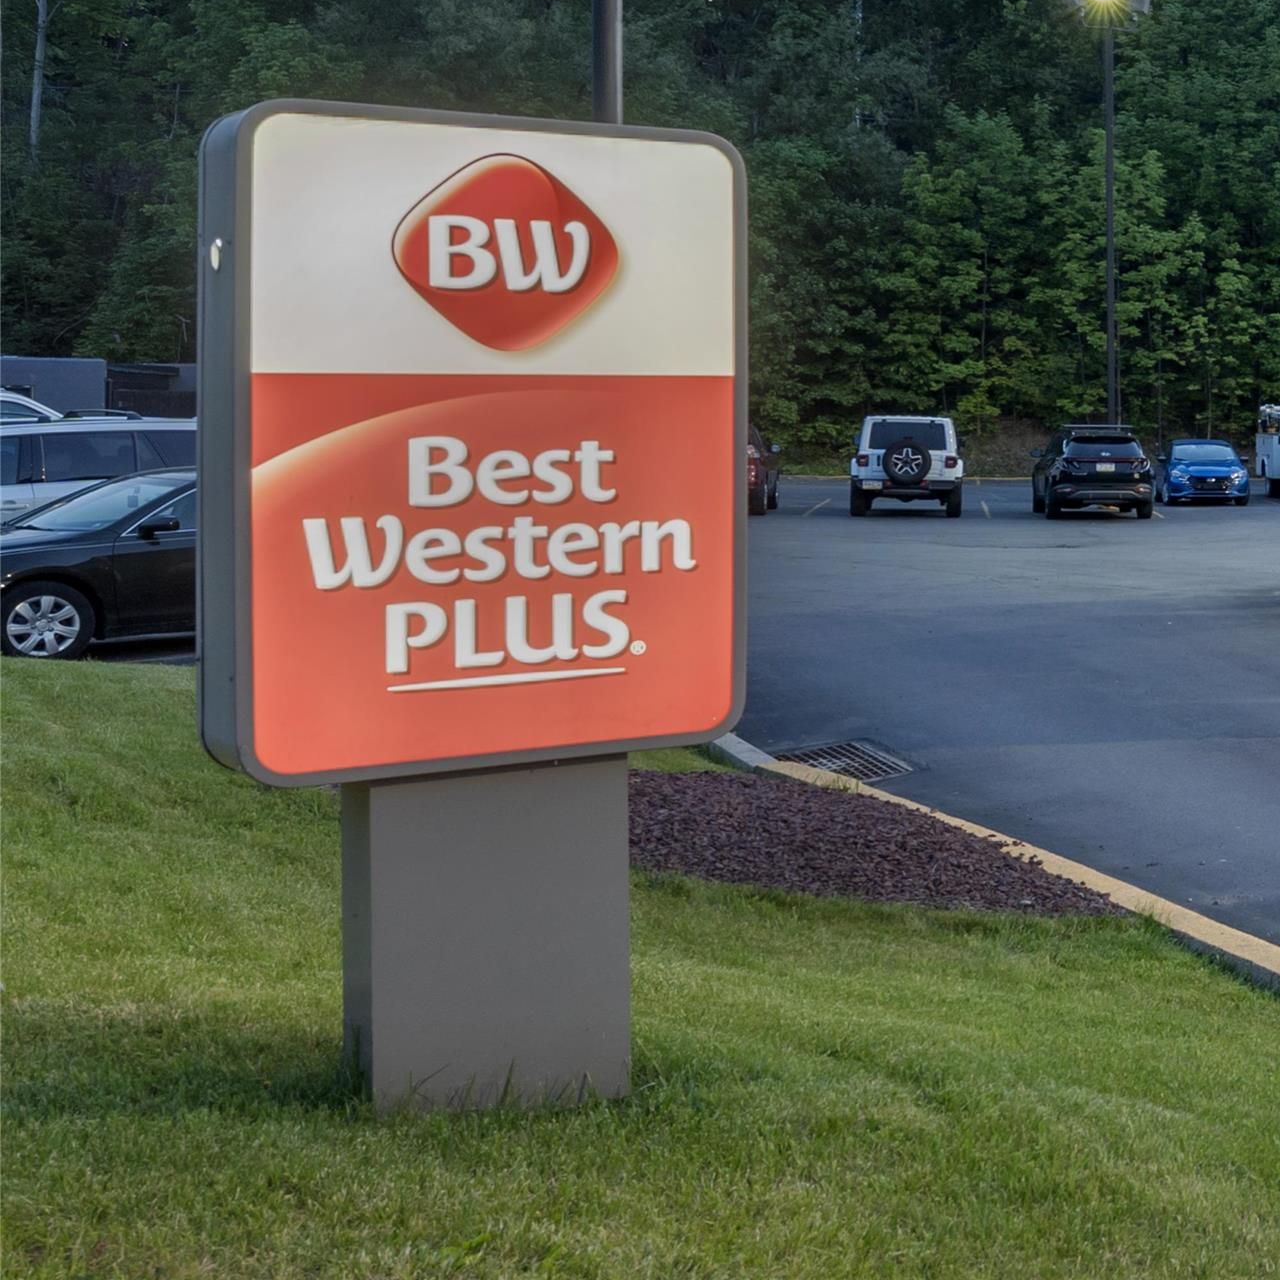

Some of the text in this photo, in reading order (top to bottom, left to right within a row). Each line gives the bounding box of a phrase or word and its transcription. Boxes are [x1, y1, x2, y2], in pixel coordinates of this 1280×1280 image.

[428, 214, 589, 293] BW
[408, 435, 616, 506] Best
[303, 515, 697, 589] Western
